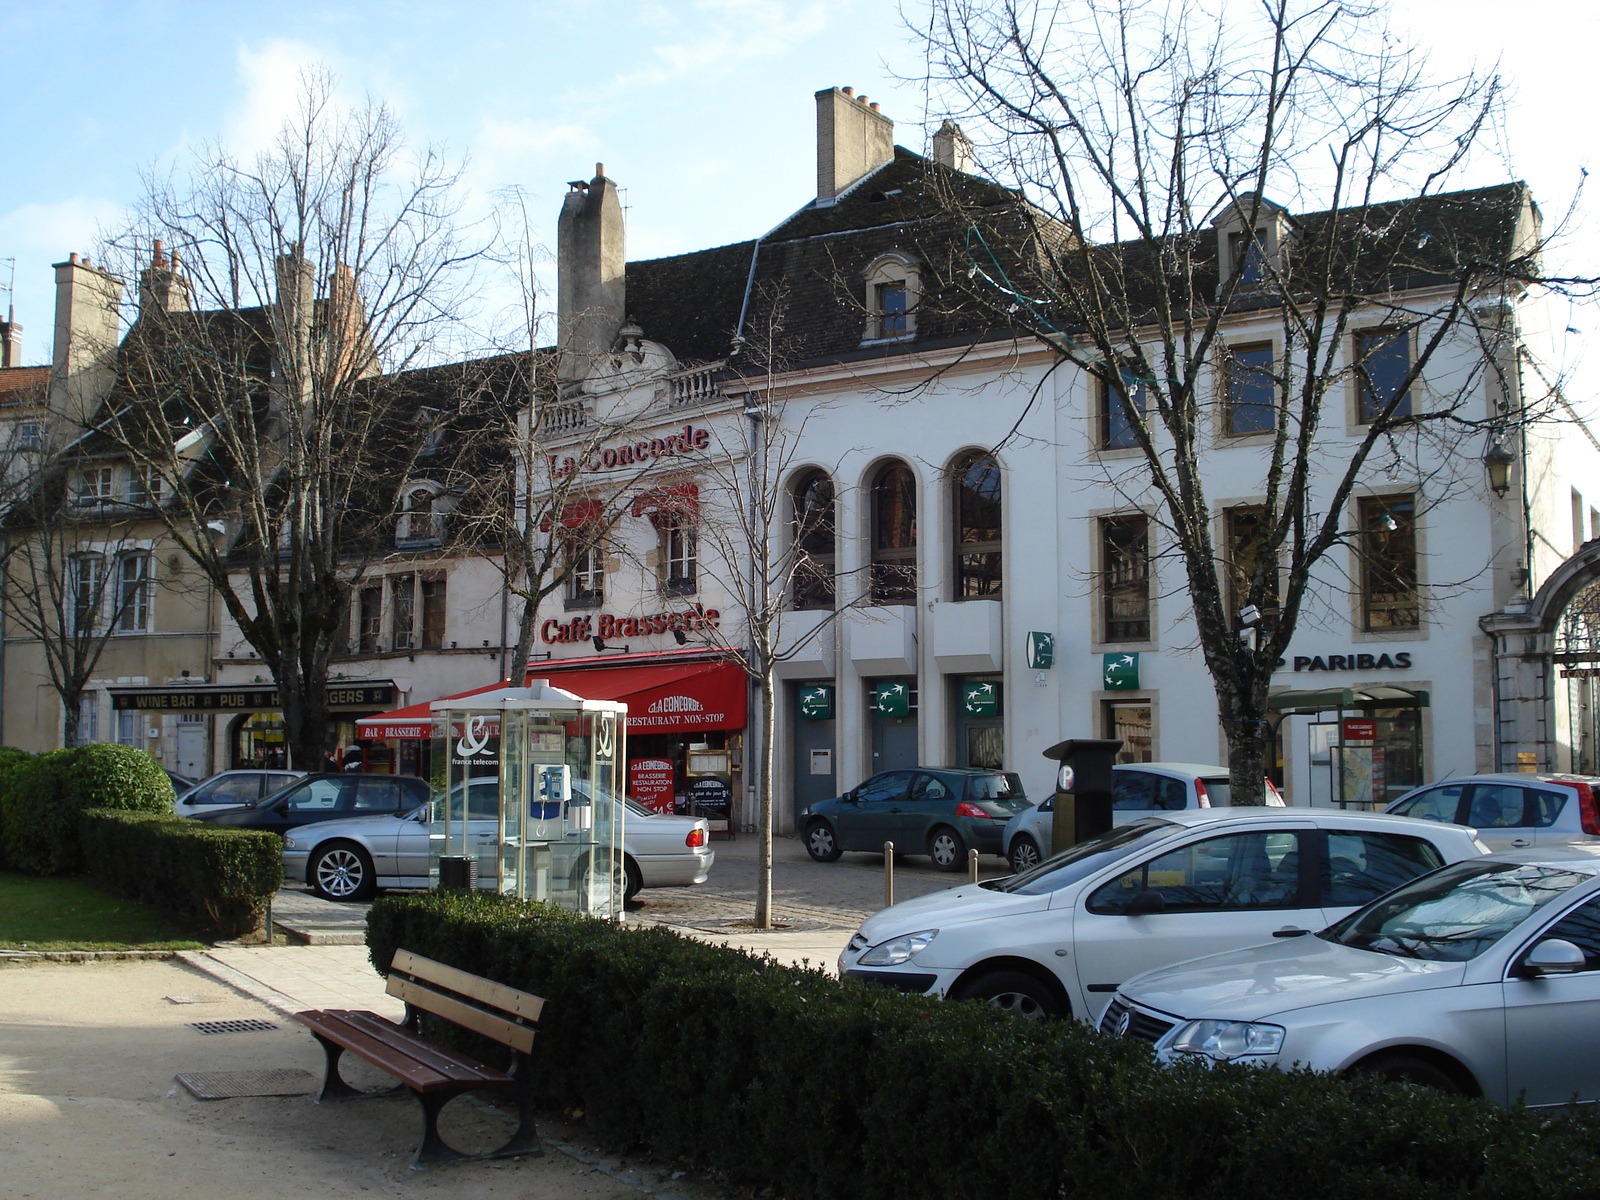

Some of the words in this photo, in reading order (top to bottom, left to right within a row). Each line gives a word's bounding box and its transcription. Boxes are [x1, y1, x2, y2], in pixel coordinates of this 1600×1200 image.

[546, 454, 576, 478] La
[584, 425, 710, 472] Concorde
[541, 614, 592, 645] Café
[597, 602, 721, 640] Brasserie
[1294, 652, 1413, 671] PARIBAS
[136, 695, 168, 708] WINE
[171, 695, 196, 707] BAR
[220, 694, 246, 706] PUB
[271, 690, 364, 706] HGERS
[626, 715, 681, 726] RESTAURANT
[684, 713, 725, 724] NON-STOP
[364, 727, 379, 738] BAR
[385, 726, 422, 738] BRASSERIE
[452, 758, 472, 766] france
[473, 758, 499, 766] telecom
[1063, 766, 1074, 788] P
